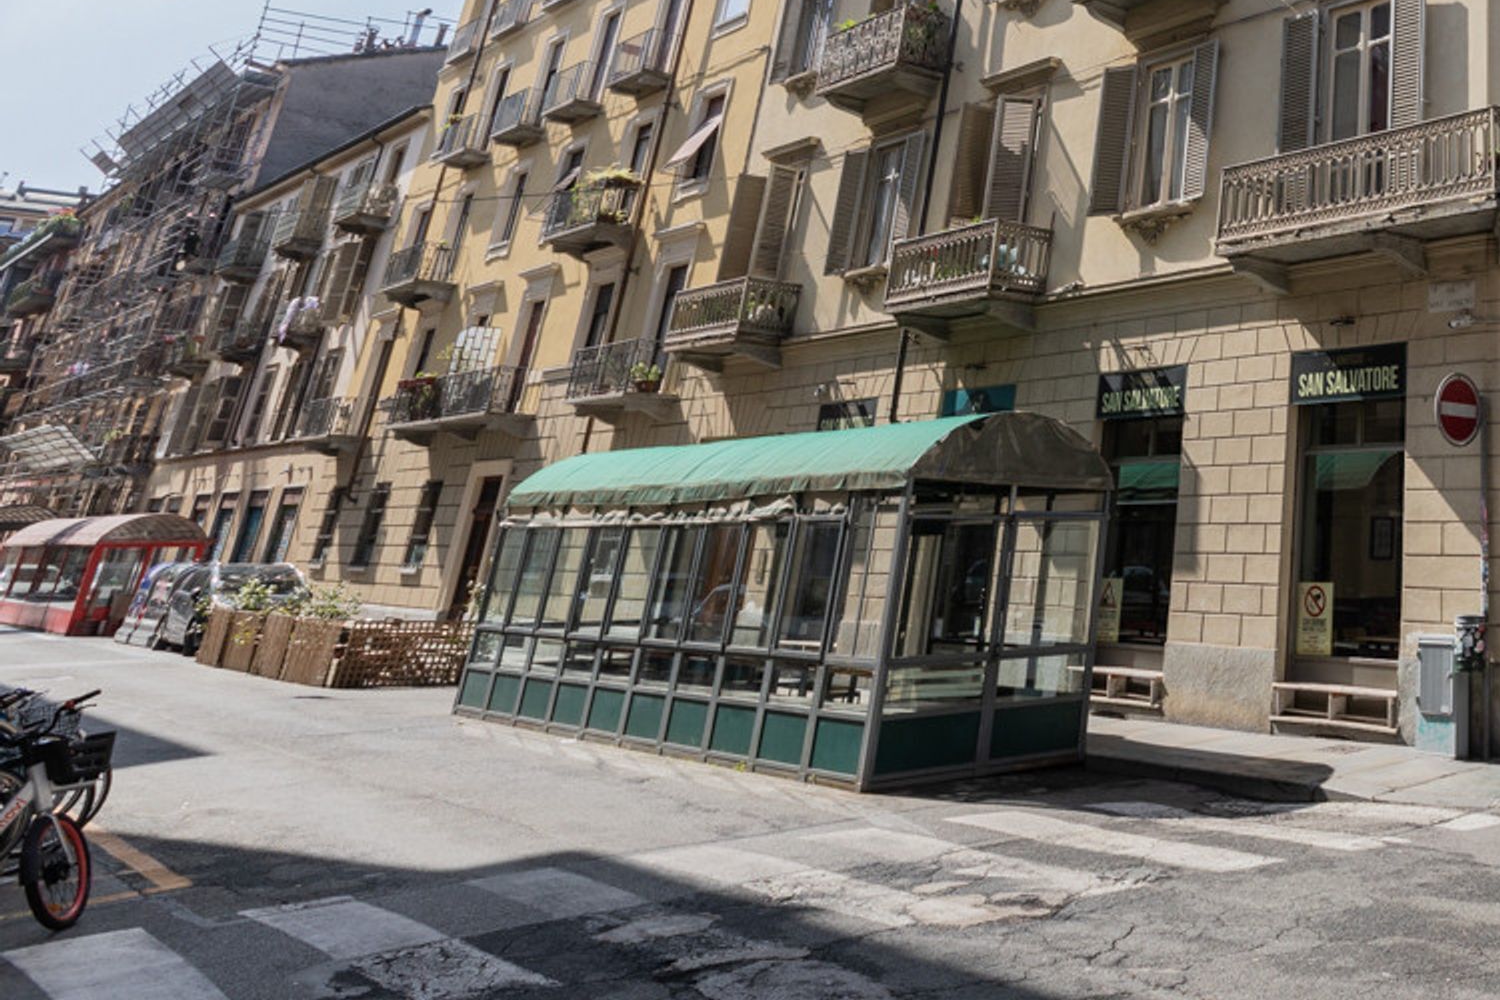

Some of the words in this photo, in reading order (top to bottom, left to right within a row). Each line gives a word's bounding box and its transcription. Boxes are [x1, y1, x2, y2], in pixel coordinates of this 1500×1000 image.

[1298, 371, 1325, 397] SAN
[1326, 365, 1399, 395] SALVATORE
[1101, 391, 1121, 413] SAN
